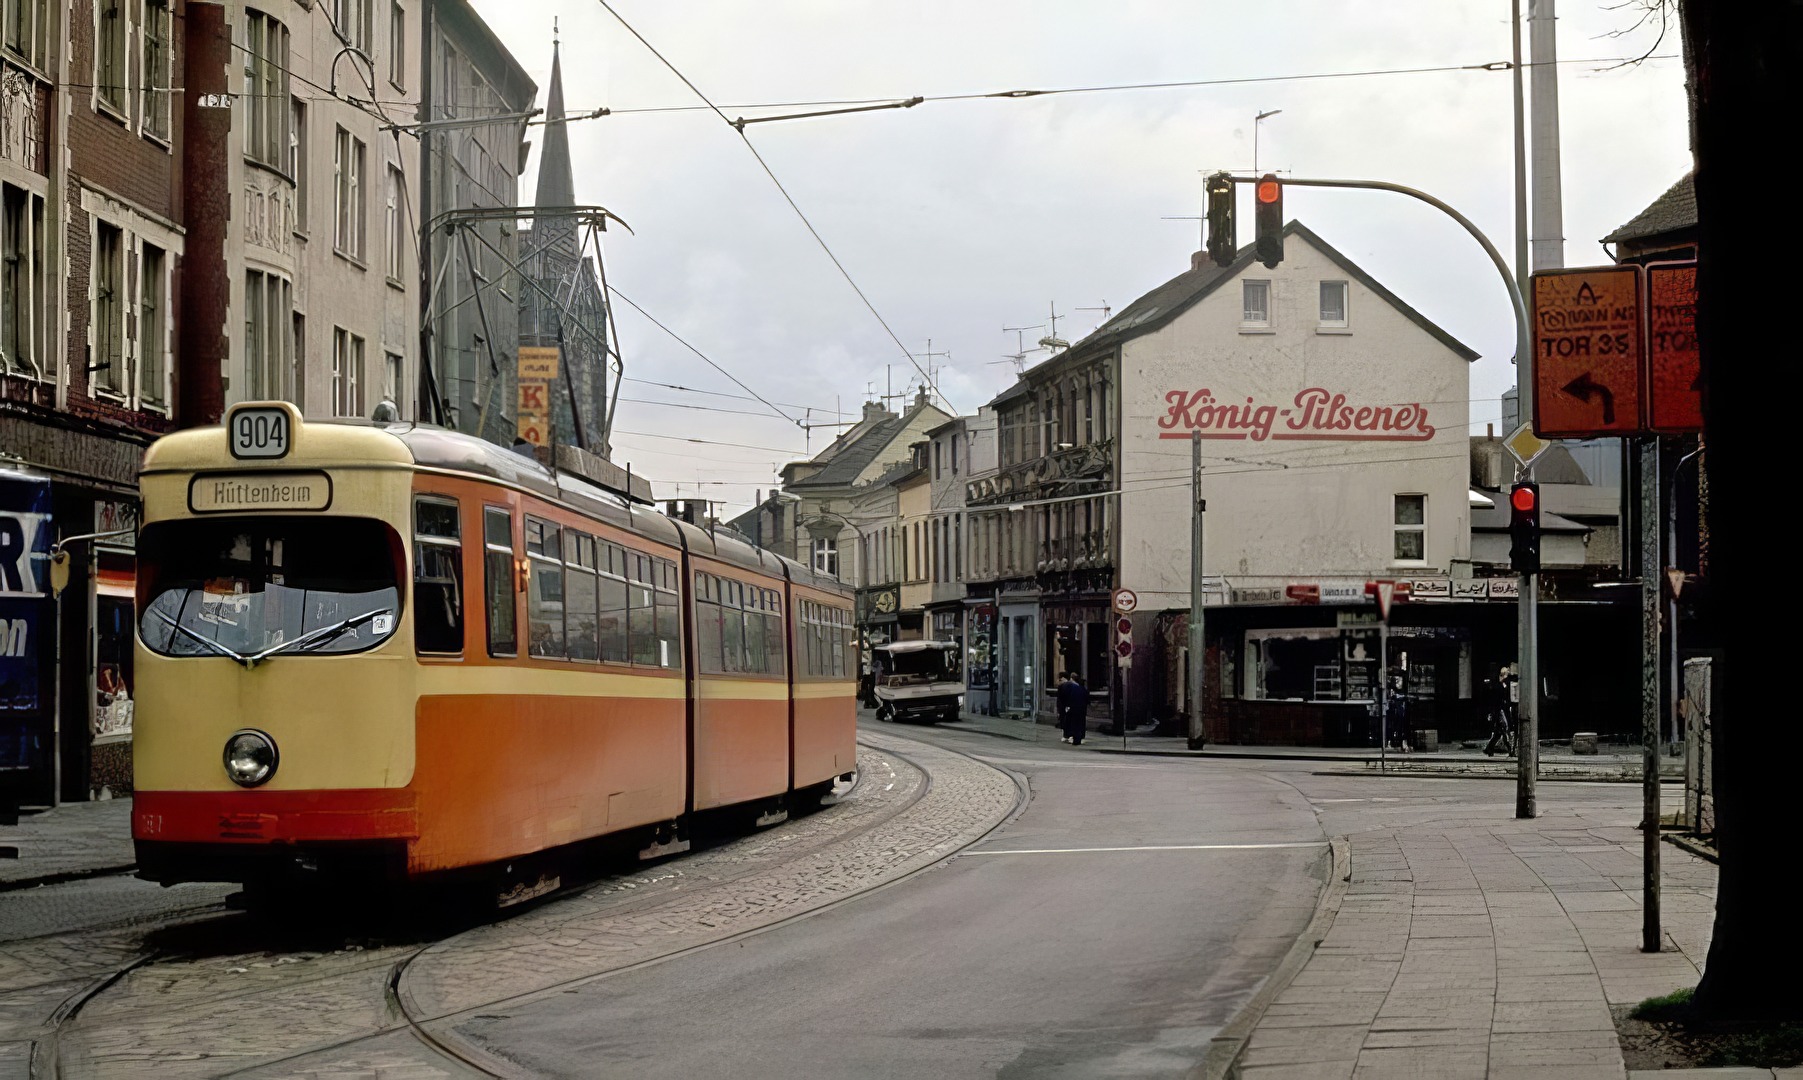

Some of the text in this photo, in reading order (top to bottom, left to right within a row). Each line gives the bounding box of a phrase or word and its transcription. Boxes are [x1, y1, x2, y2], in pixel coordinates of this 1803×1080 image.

[1541, 332, 1630, 358] TOR 35
[1157, 387, 1436, 442] König-Pilsener
[239, 415, 284, 449] 904
[214, 481, 311, 504] Hüttenheim
